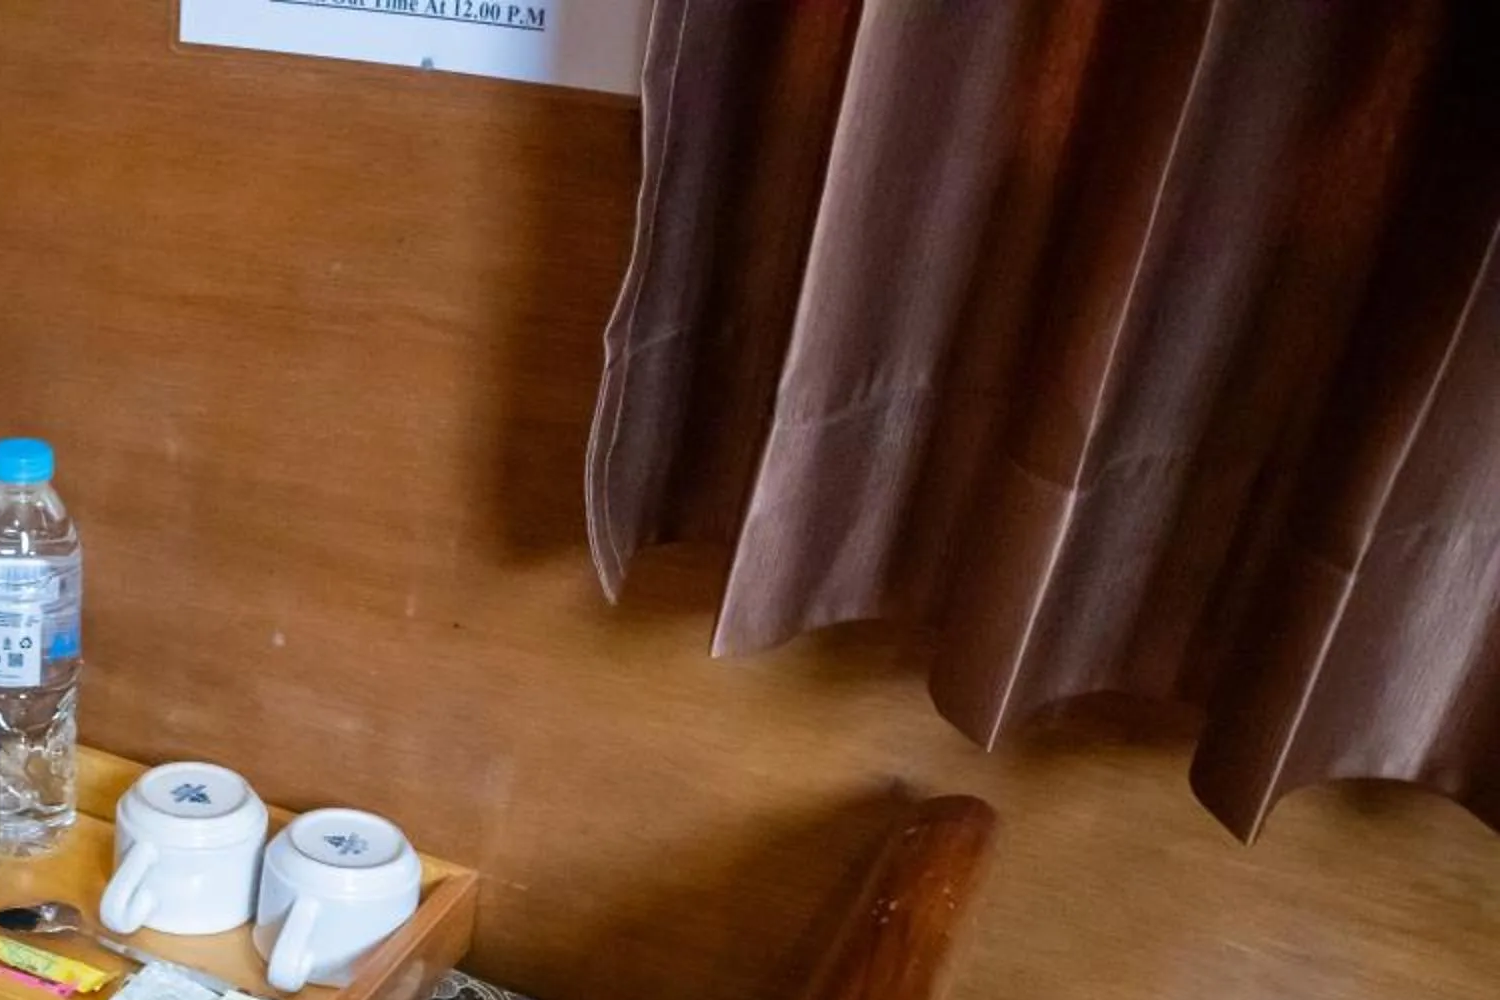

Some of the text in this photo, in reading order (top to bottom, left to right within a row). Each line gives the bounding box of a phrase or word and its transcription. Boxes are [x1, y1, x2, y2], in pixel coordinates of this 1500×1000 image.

[426, 0, 446, 14] At
[454, 0, 501, 20] 12.00
[507, 5, 545, 27] P.M
